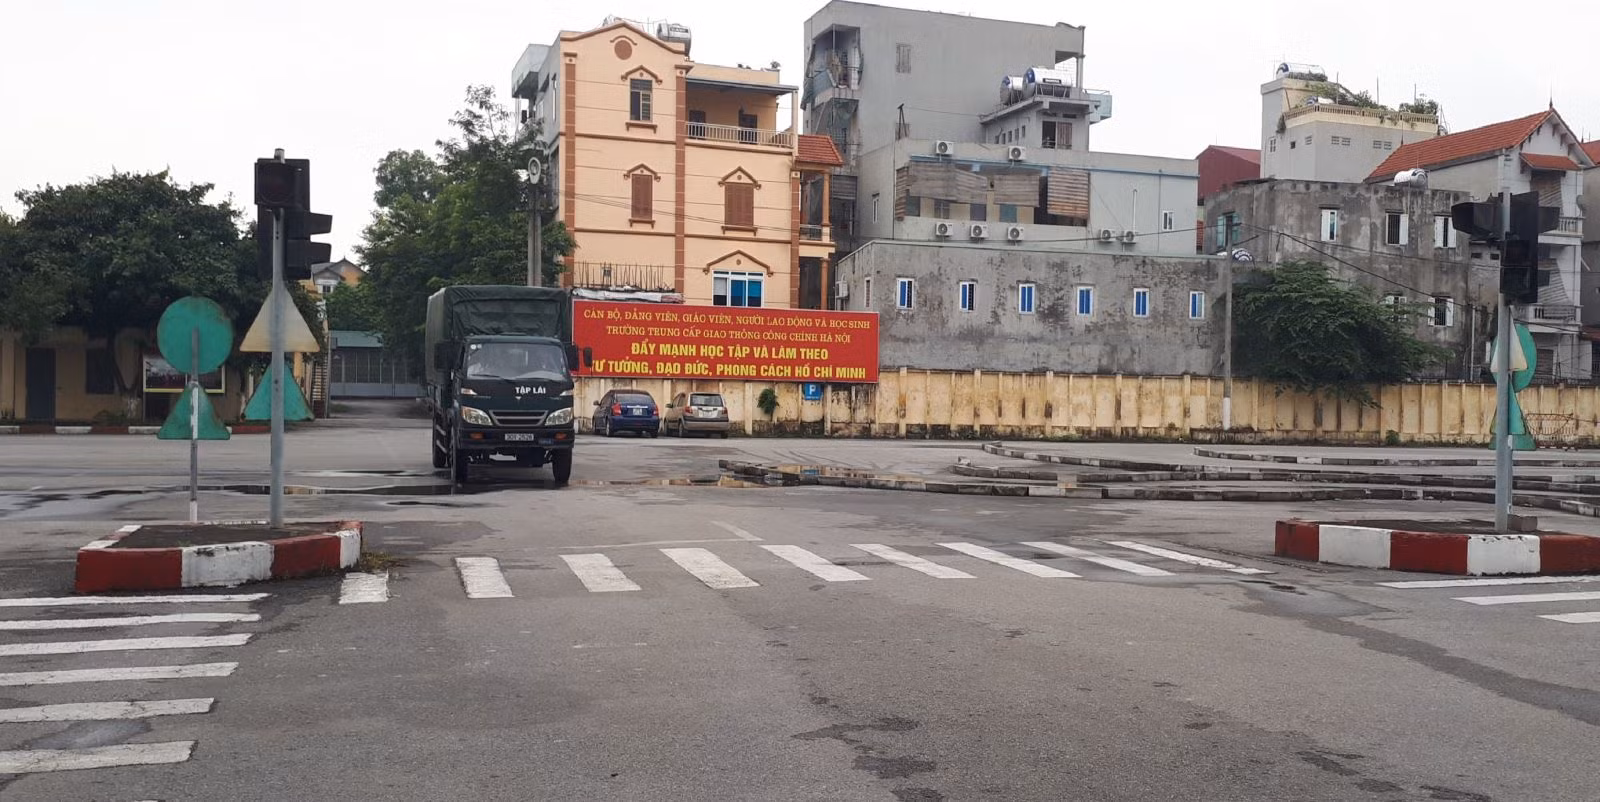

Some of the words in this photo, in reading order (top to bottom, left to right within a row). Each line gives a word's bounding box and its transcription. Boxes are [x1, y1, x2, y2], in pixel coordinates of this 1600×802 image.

[607, 308, 622, 321] BỘ,
[625, 308, 652, 321] ĐẢNG
[655, 311, 680, 322] VIÊN,
[683, 311, 705, 323] GIÁO
[708, 313, 733, 325] VIÊN,
[736, 314, 764, 325] NGƯỜI
[767, 317, 785, 326] LAO
[787, 316, 812, 328] ĐỘNG
[815, 317, 827, 328] VÀ
[830, 319, 847, 330] HỌC
[849, 320, 870, 329] SINH
[606, 324, 645, 336] TRƯỜNG
[648, 327, 680, 337] TRUNG
[683, 325, 701, 337] CẤP
[703, 329, 726, 339] GIAO
[729, 328, 760, 340] THÔNG
[762, 329, 787, 340] CÔNG
[789, 331, 818, 342] CHÍNH
[820, 332, 832, 343] HÀ
[835, 332, 850, 344] NỘI
[631, 338, 656, 355] ĐẨY
[659, 344, 696, 358] MẠNH
[700, 345, 723, 359] HỌC
[728, 344, 750, 360] TẬP
[753, 345, 768, 358] VÀ
[772, 345, 796, 359] LÀM
[800, 348, 828, 360] THEO
[608, 356, 652, 374] TƯỞNG,
[656, 362, 680, 376] ĐẠO
[684, 360, 712, 376] ĐỨC,
[716, 363, 756, 376] PHONG
[760, 363, 791, 377] CÁCH
[814, 365, 832, 378] CHÍ
[836, 367, 866, 379] MINH
[515, 386, 531, 395] TẬP
[533, 385, 546, 394] LÁI
[810, 385, 816, 395] P
